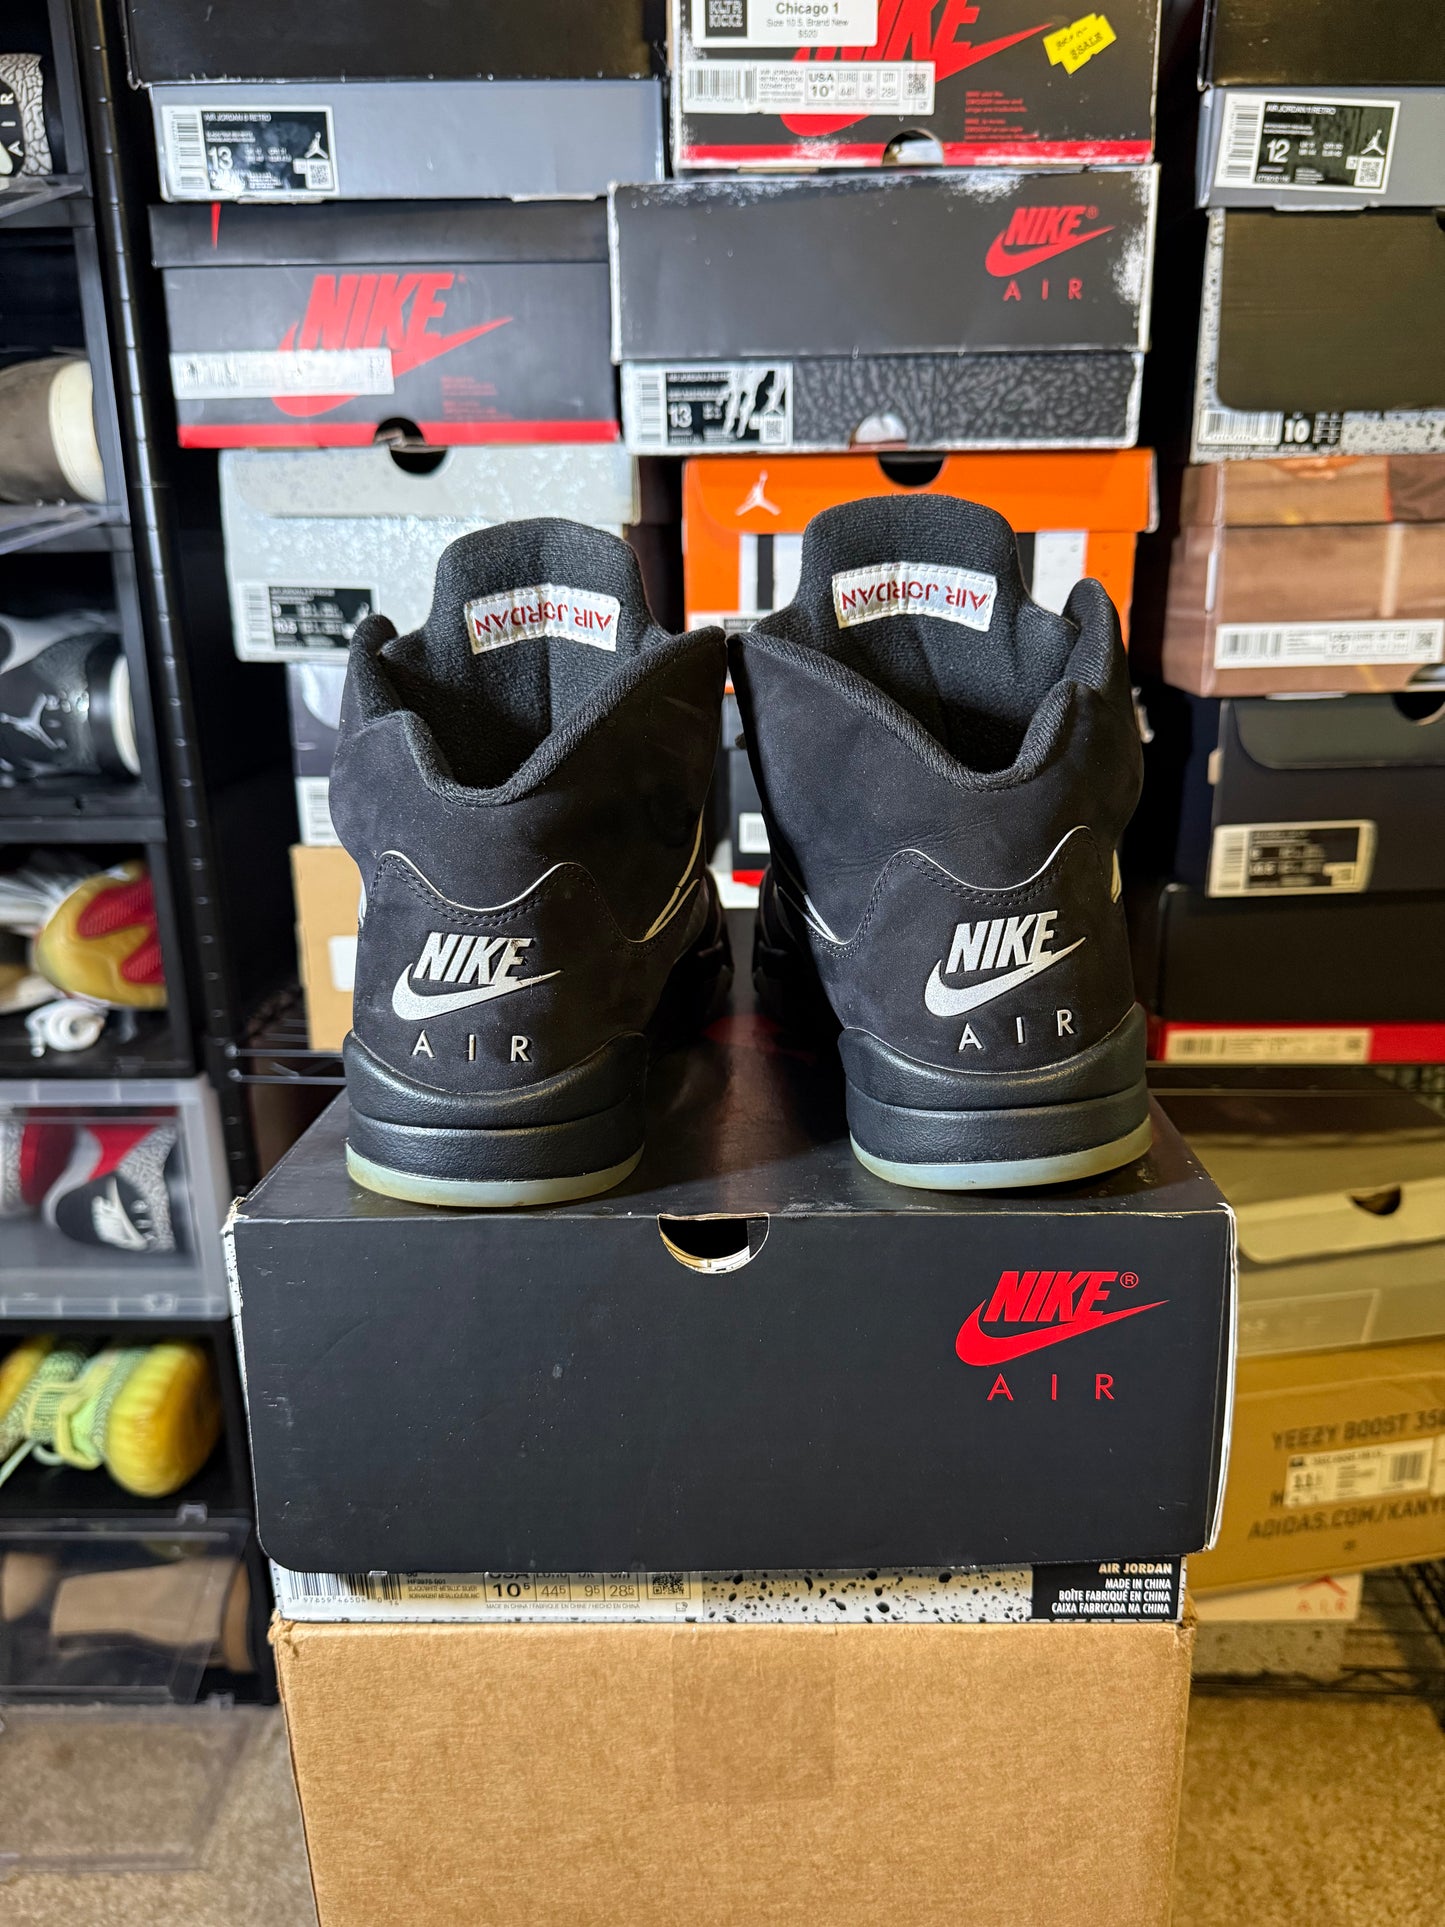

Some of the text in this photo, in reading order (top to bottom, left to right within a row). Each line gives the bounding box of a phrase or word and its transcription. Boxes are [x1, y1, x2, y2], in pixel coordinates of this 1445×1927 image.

[776, 2, 839, 17] Chicago 1
[808, 72, 835, 83] USA
[208, 146, 234, 170] 13
[1267, 138, 1291, 163] 12
[1003, 205, 1087, 246] NIKE
[1003, 277, 1083, 301] AIR
[300, 272, 456, 350] NIKE
[668, 402, 693, 428] 13
[1284, 418, 1311, 443] 10
[840, 580, 988, 612] AIR JORDAN
[474, 601, 613, 636] AIR JORDAN
[945, 909, 1058, 975] NIKE
[413, 931, 533, 986] NIKE
[958, 1008, 1075, 1052] AIR
[411, 1029, 531, 1062] AIR
[982, 1270, 1119, 1323] NIKE
[986, 1372, 1115, 1401] AIR
[1272, 1423, 1339, 1450] YEEZY
[1343, 1412, 1409, 1441] BOOST
[1098, 1563, 1173, 1574] AIR JORDAN
[1058, 1588, 1083, 1602] BOÎTE
[1129, 1590, 1141, 1602] EN
[1105, 1578, 1172, 1590] MADE IN CHINA
[1051, 1602, 1170, 1614] CAIXA FABRICADA NA CHINA
